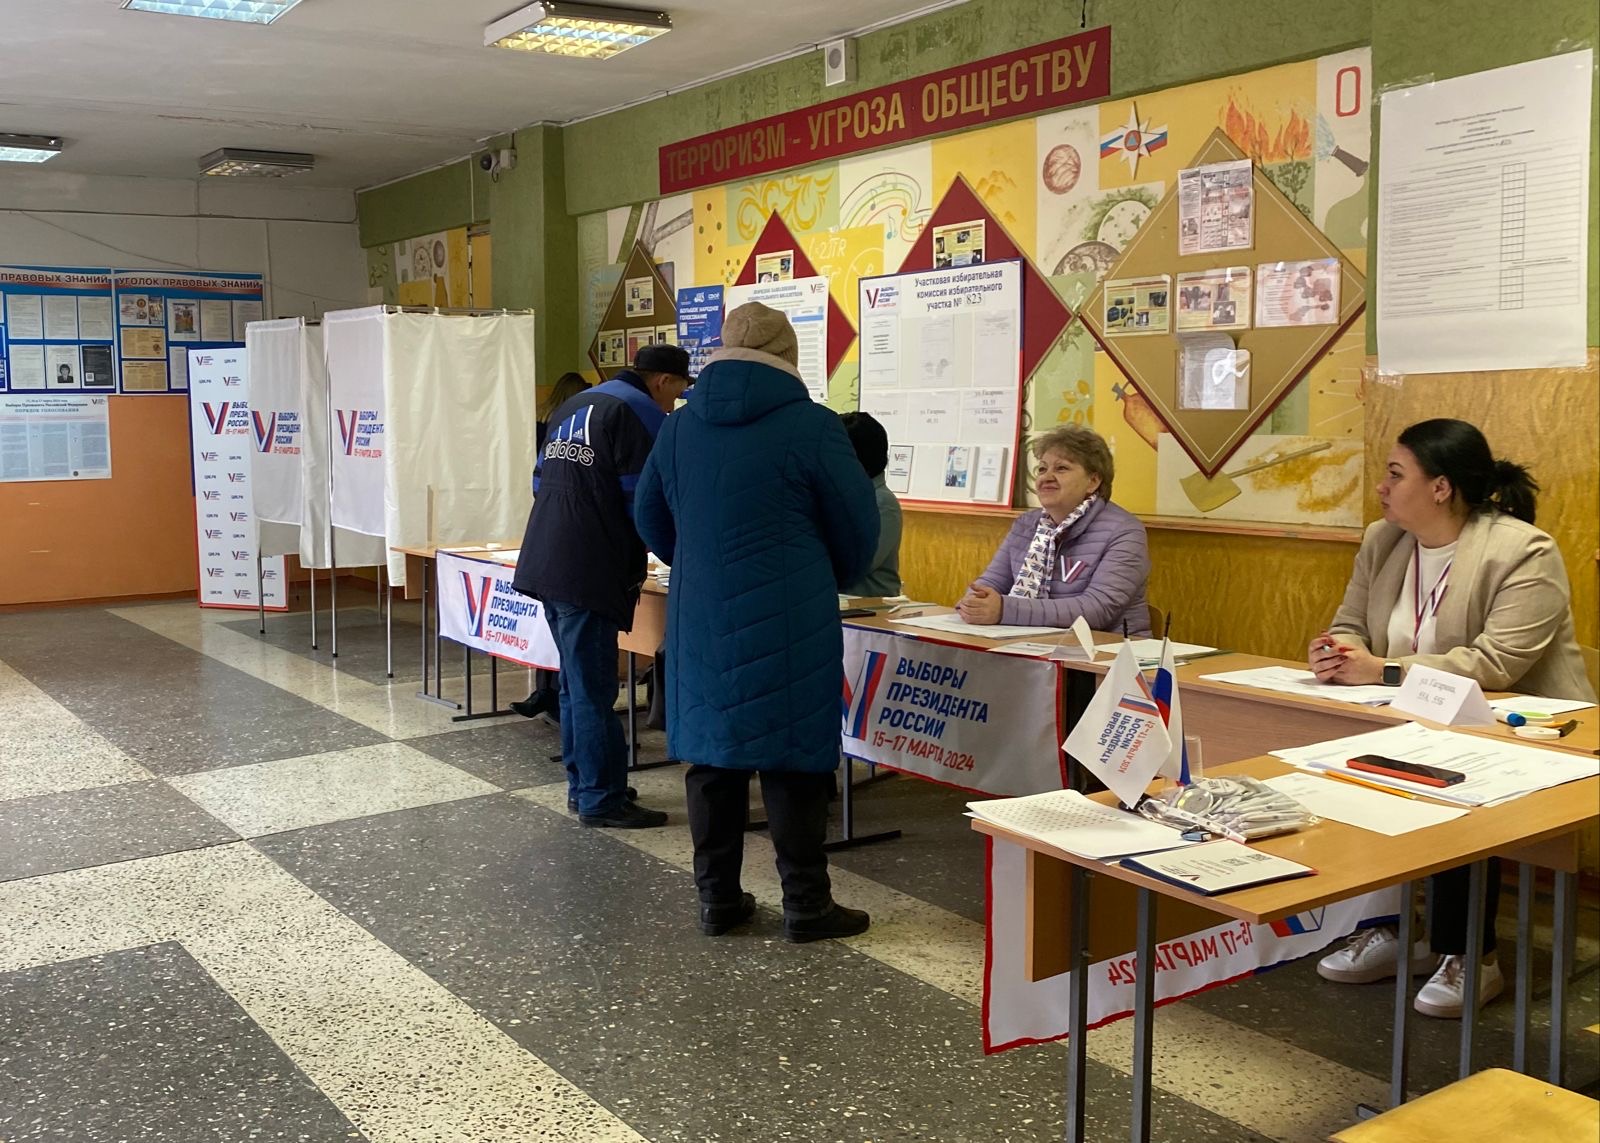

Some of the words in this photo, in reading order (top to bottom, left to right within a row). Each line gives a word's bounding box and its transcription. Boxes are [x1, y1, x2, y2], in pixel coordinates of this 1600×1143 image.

[666, 122, 786, 183] ТЕРРОРИЗМ
[808, 92, 905, 150] УГРОЗА
[921, 41, 1097, 123] ОБЩЕСТВУ
[1, 273, 61, 282] ПРАВОВЫХ
[65, 274, 108, 283] ЗНАНИЙ
[119, 277, 162, 286] УГОЛОК
[162, 278, 218, 287] ПРАВОВЫХ
[220, 279, 259, 289] ЗНАНИЙ
[914, 276, 951, 287] Участковая
[952, 269, 1003, 283] избирательная
[917, 288, 947, 299] комиссия
[948, 282, 1003, 296] избирательного
[926, 299, 952, 313] участка
[953, 297, 962, 307] №
[966, 292, 982, 305] 823
[487, 613, 518, 632] РОССИИ
[895, 656, 968, 689] ВЫБОРЫ
[886, 682, 989, 723] ПРЕЗИДЕНТА
[878, 706, 946, 739] РОССИИ
[906, 738, 944, 763] МАРТА
[943, 751, 975, 771] 2024
